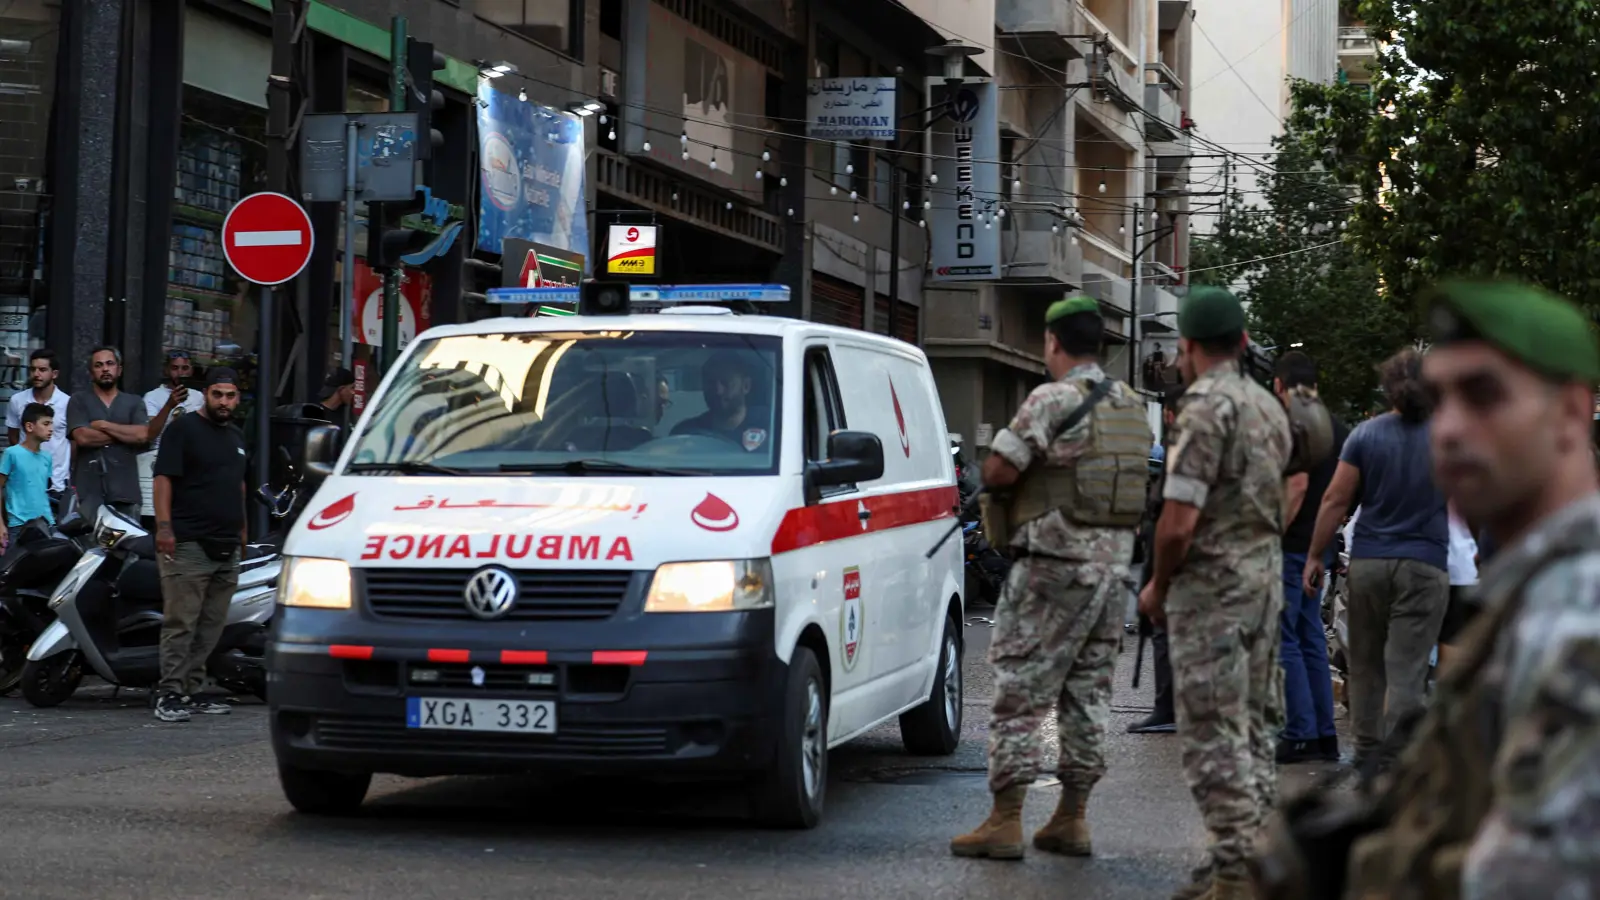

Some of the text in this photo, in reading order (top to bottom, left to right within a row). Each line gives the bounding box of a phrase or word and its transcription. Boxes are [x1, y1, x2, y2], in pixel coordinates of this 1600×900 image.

[817, 116, 890, 126] MARIGNAN
[855, 129, 896, 137] CENTER
[393, 494, 648, 520] إسعاف
[425, 700, 549, 729] XGA 332
